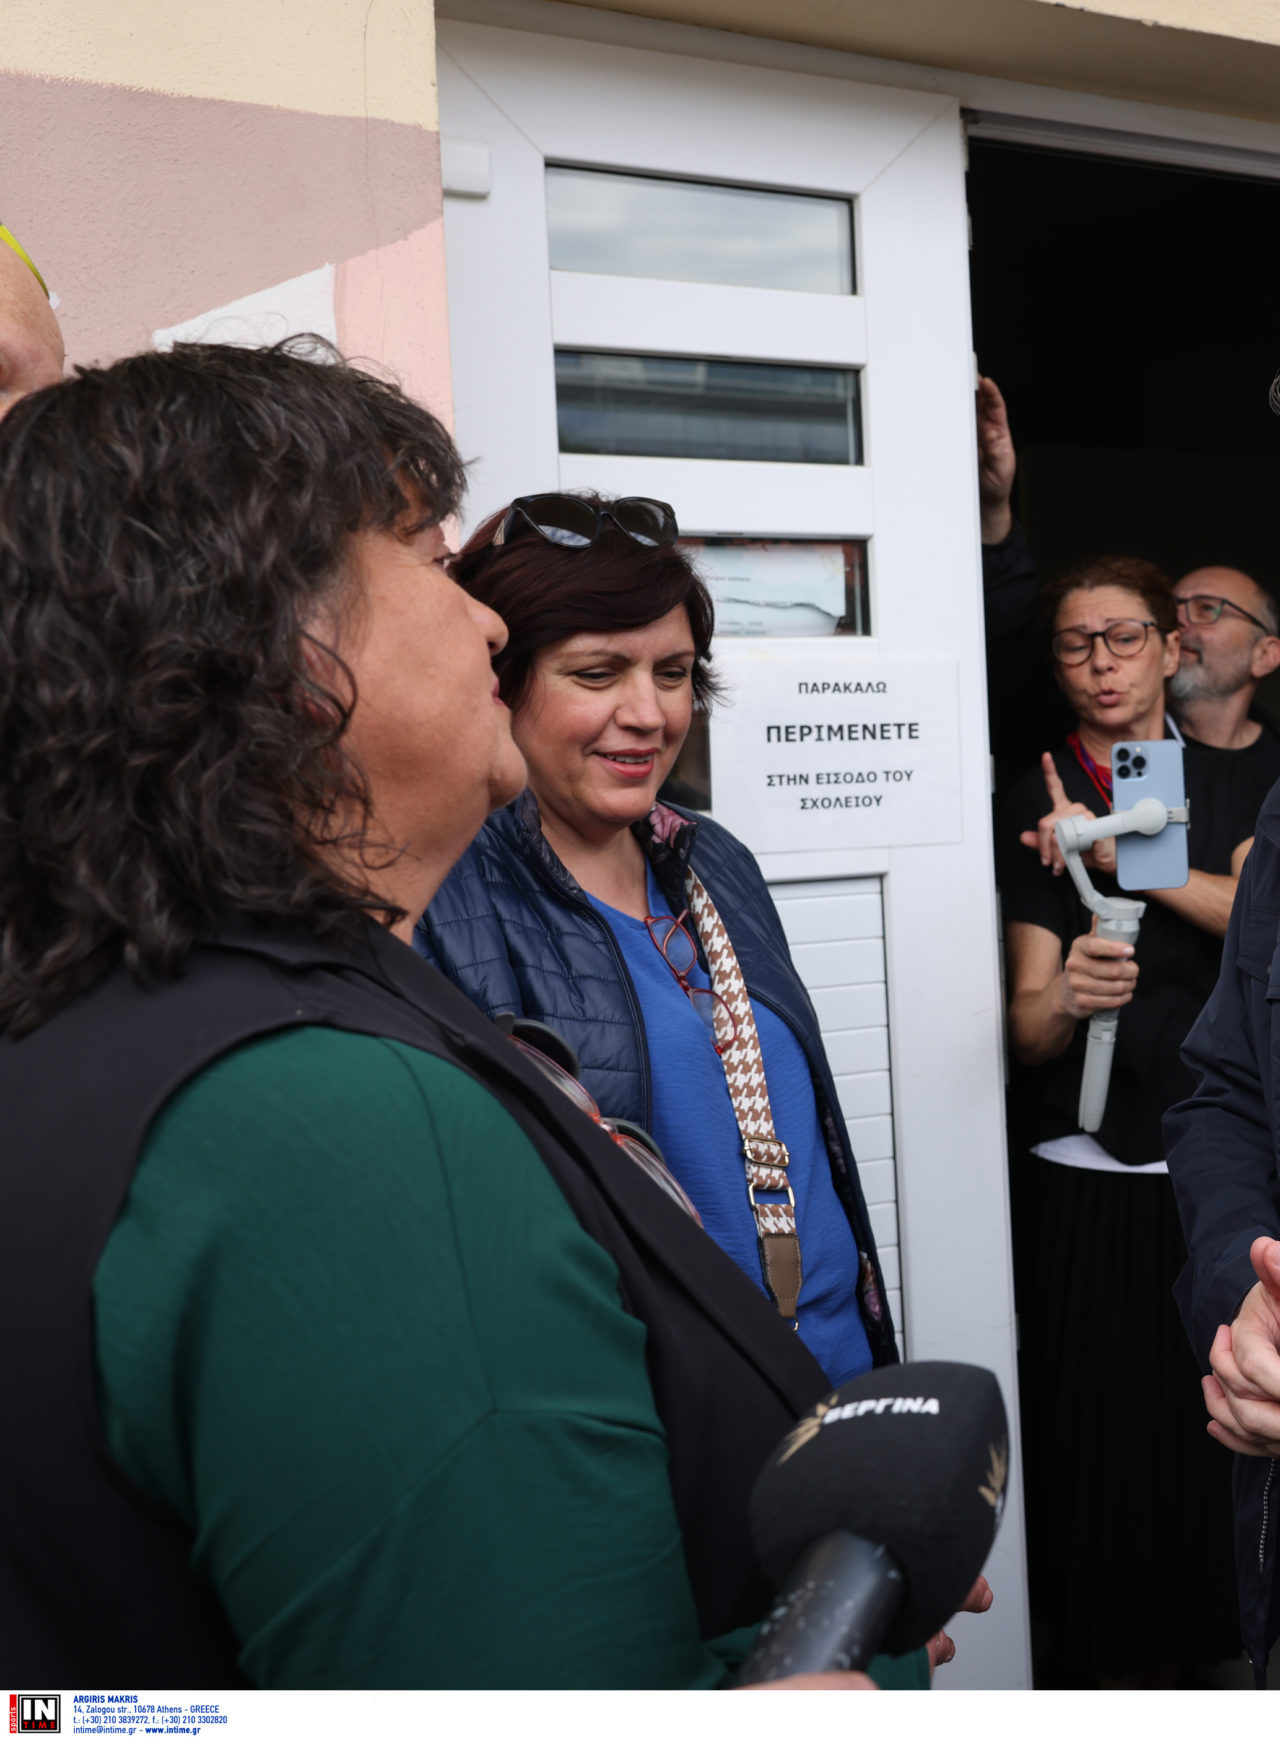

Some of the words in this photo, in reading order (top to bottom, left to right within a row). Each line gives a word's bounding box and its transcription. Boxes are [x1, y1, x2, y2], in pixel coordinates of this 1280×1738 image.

[798, 682, 887, 694] ΠΑΡΑΚΑΛΩ
[766, 722, 920, 743] ΠΕΡΙΜΕΝΕΤΕ
[766, 773, 810, 787] ΣΤΗΝ
[815, 770, 878, 786] ΕΙΣΟΔΟ
[883, 770, 914, 783] ΤΟΥ
[800, 795, 883, 810] ΣΧΟΛΕΙΟΥ
